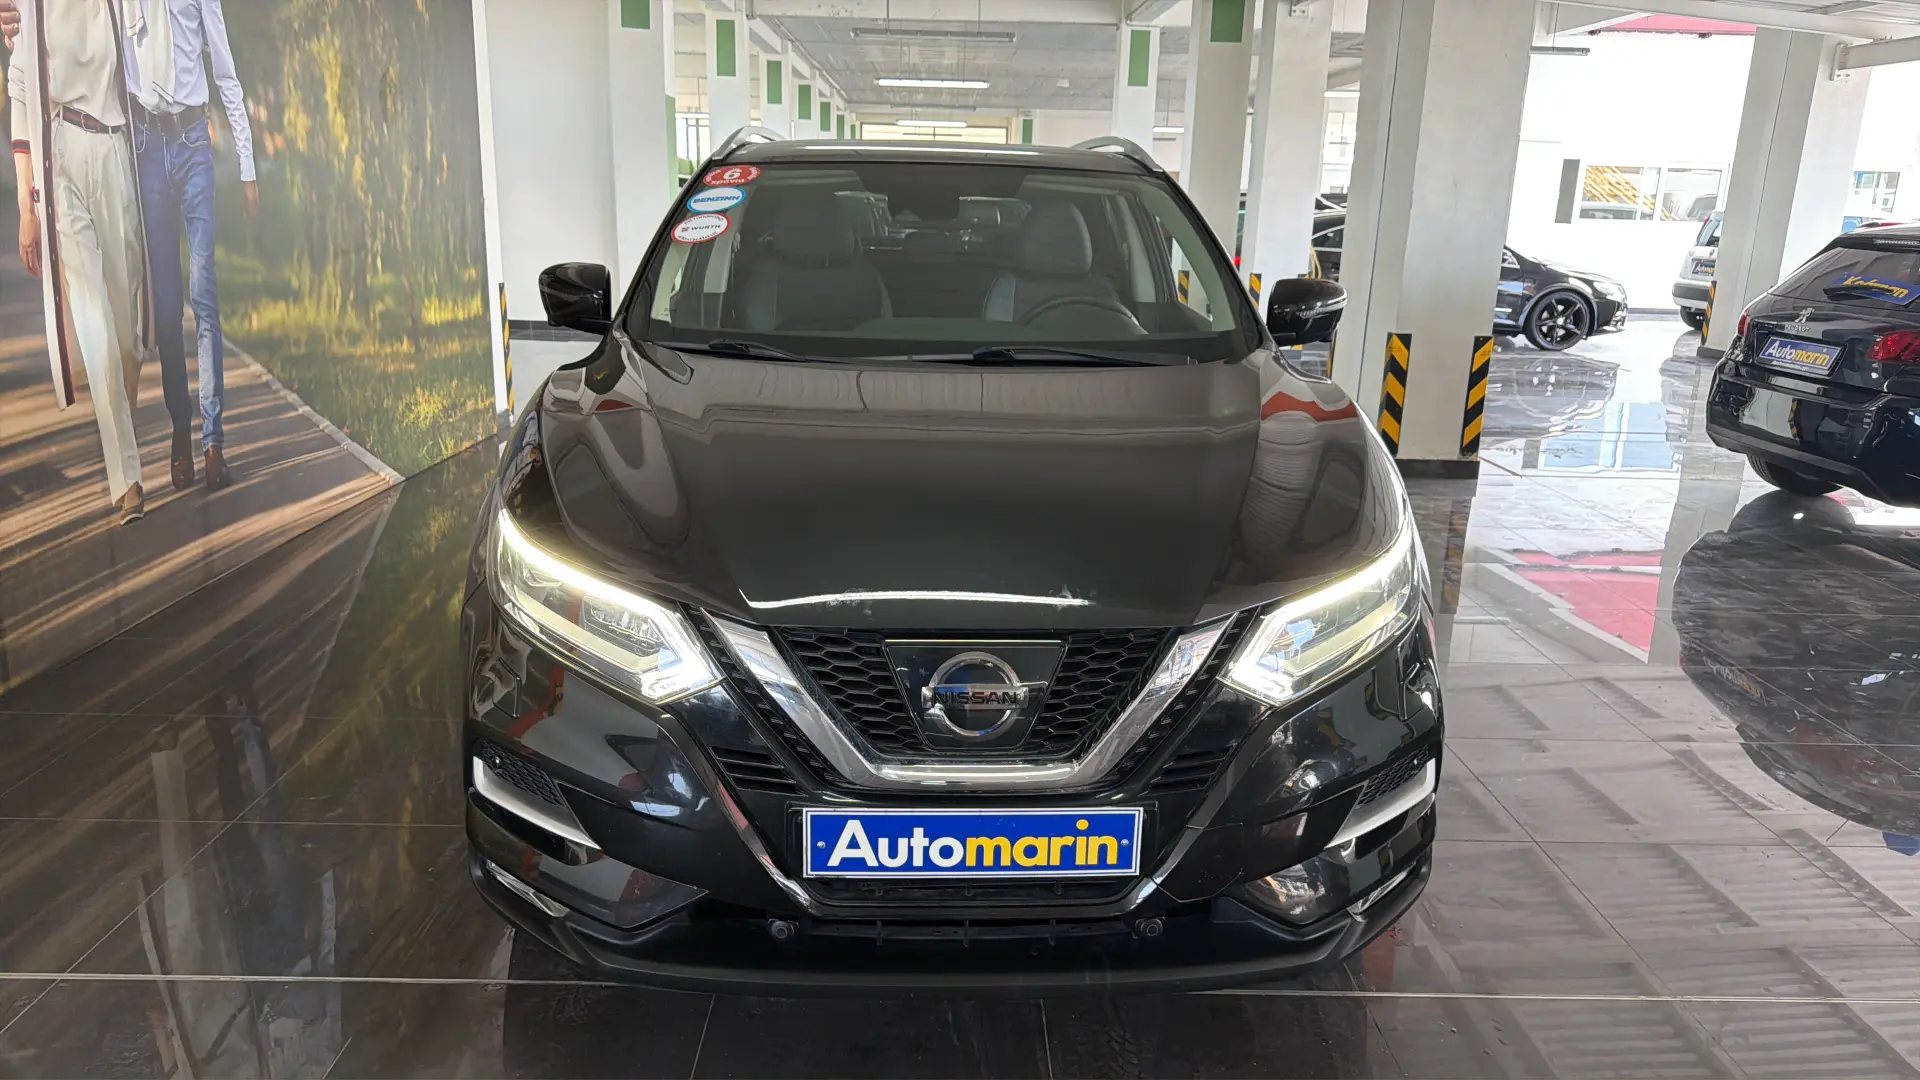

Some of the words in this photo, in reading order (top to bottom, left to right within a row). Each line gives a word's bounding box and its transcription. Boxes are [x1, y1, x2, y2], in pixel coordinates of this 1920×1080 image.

[723, 169, 742, 180] 6
[1785, 324, 1810, 332] PEUGEOT
[1765, 340, 1830, 366] Automarin
[933, 691, 1017, 704] NISSAN
[827, 819, 1118, 867] Automarin
